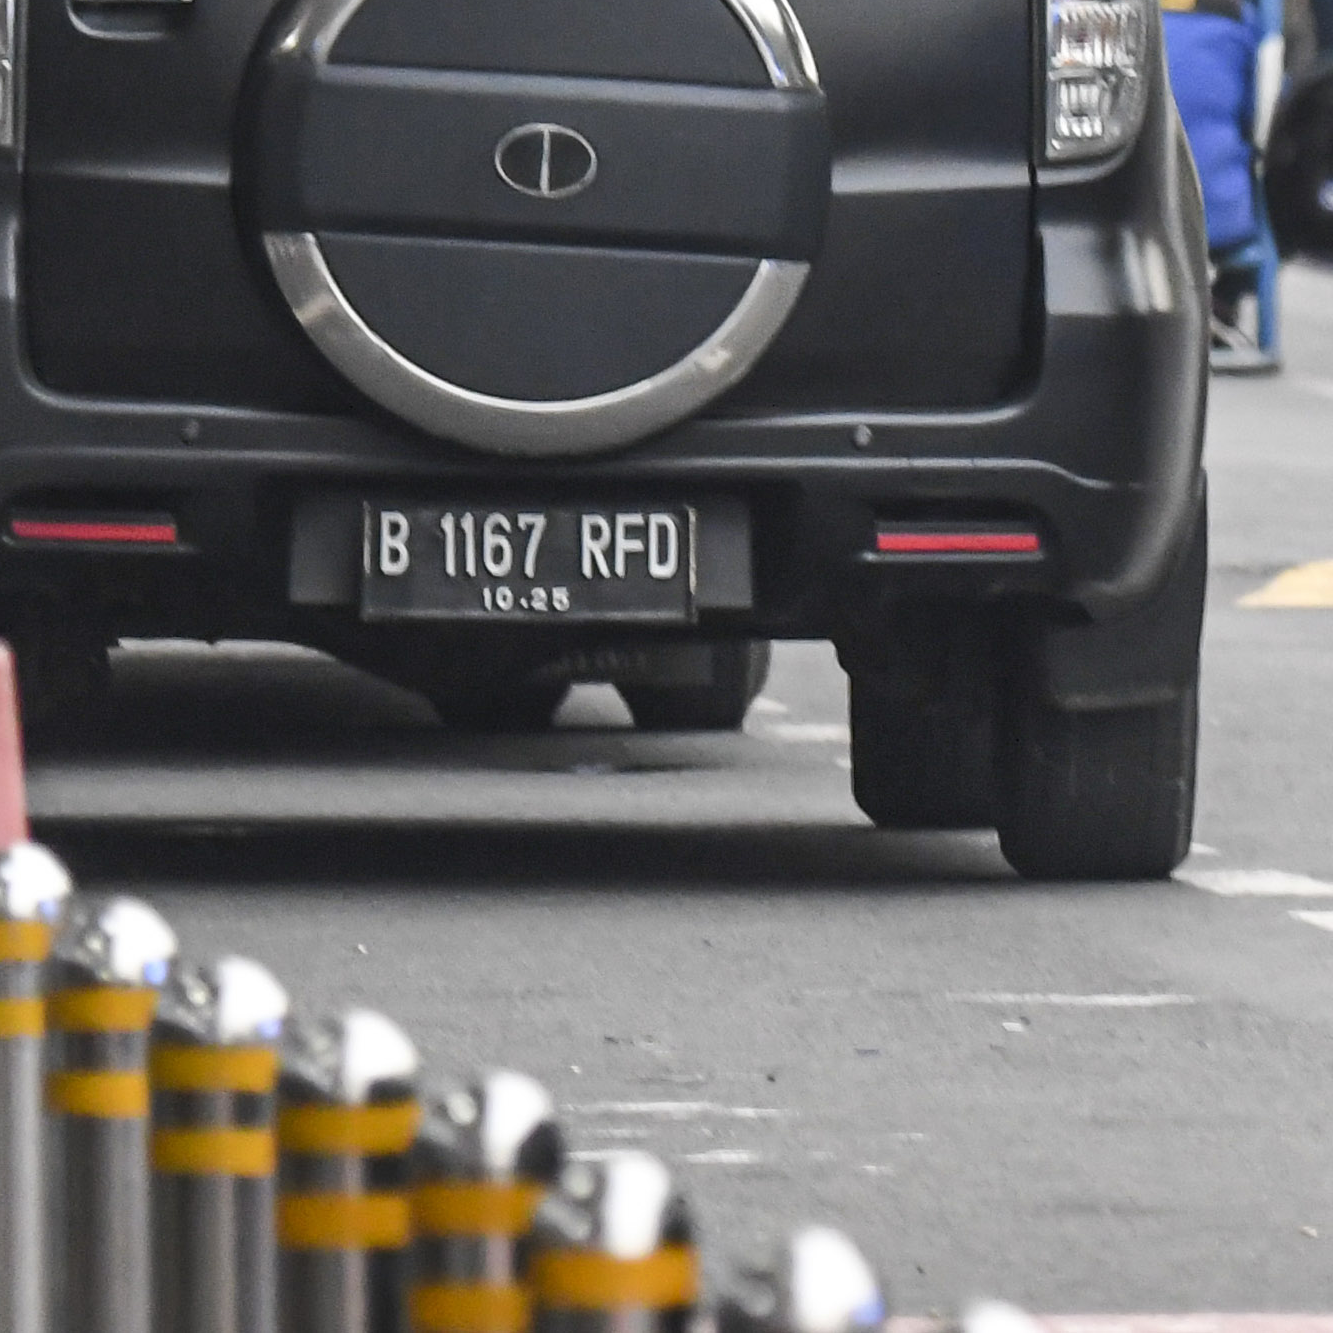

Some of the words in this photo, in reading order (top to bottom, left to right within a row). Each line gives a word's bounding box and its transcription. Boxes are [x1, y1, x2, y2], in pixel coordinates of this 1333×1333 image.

[378, 510, 411, 577] B
[439, 511, 548, 580] 1167
[580, 512, 680, 581] RFD
